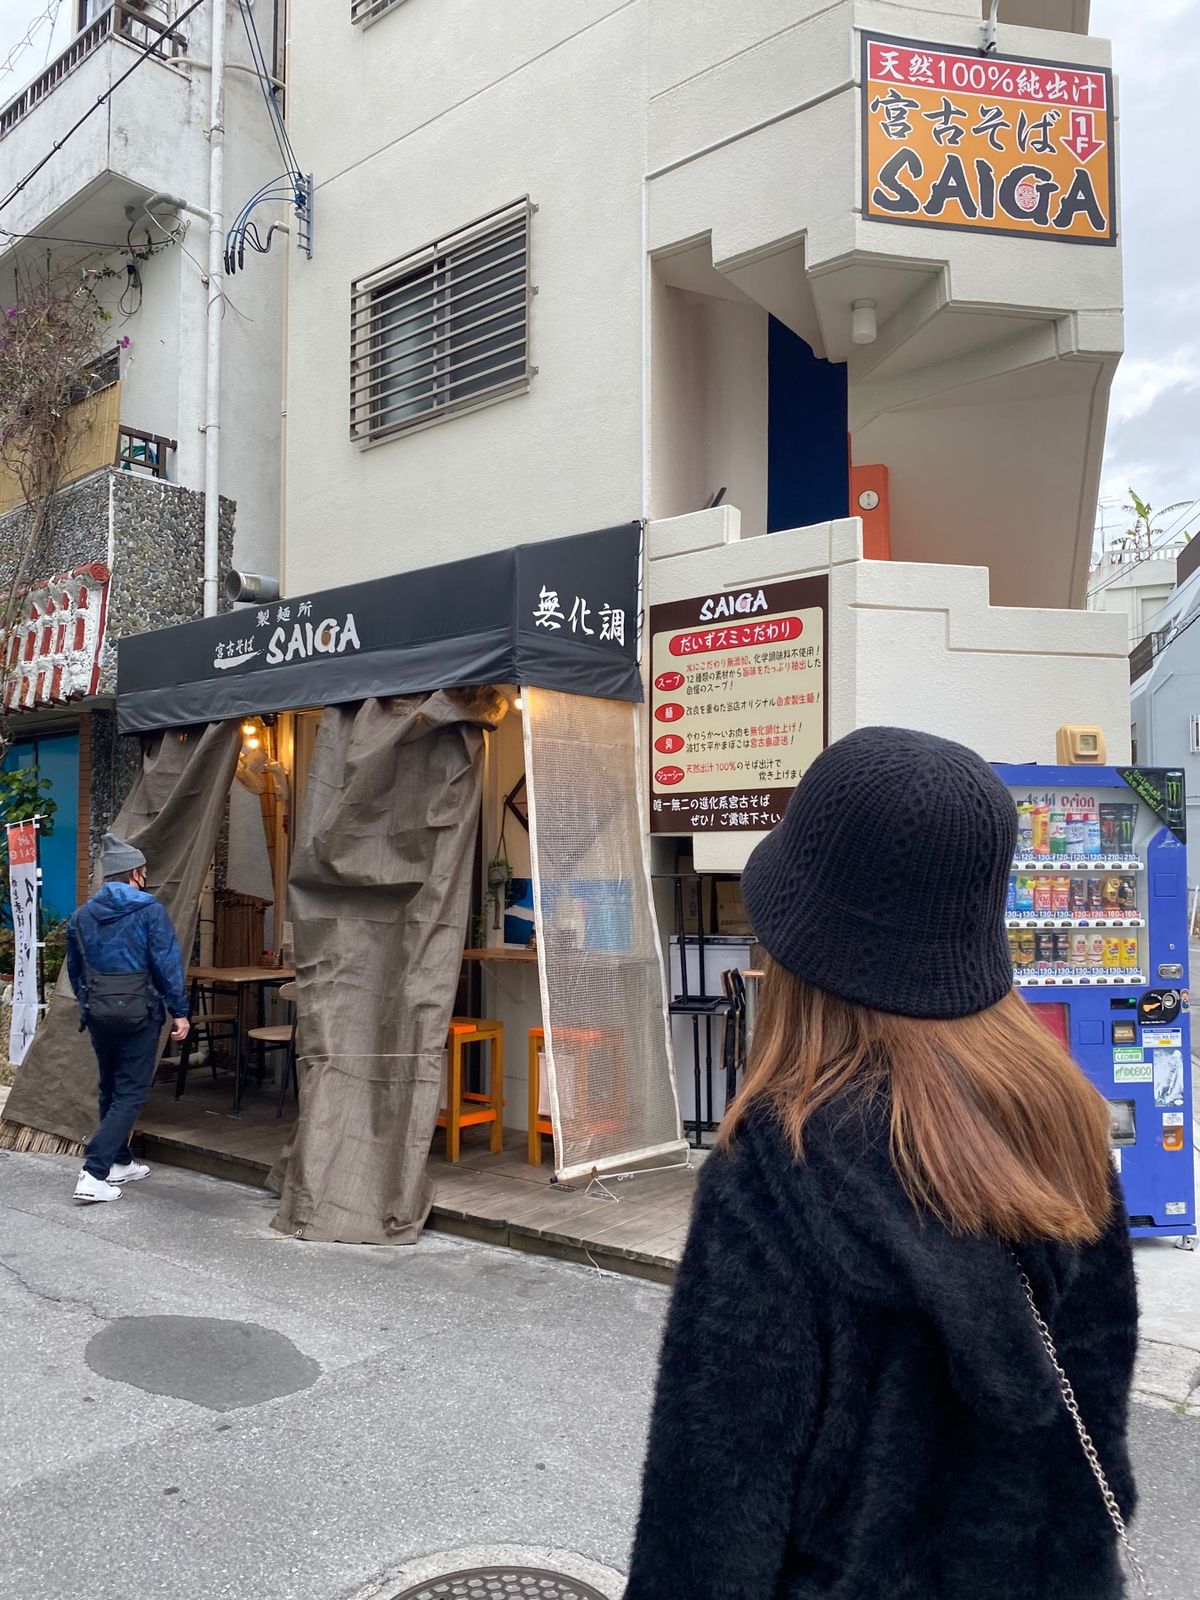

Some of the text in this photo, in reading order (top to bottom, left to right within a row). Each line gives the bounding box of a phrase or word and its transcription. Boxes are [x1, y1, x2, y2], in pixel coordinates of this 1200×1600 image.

[877, 50, 1097, 105] 天然100%純出汁
[871, 89, 1061, 154] 宮古そば
[872, 147, 1106, 231] SAIGA
[256, 600, 313, 628] 製麺所
[532, 584, 626, 647] 無化調
[699, 589, 769, 621] SAIGA
[214, 635, 255, 658] 宮古そば
[265, 612, 361, 665] SAIGA
[657, 674, 681, 689] スープ
[1060, 793, 1095, 808] Orion
